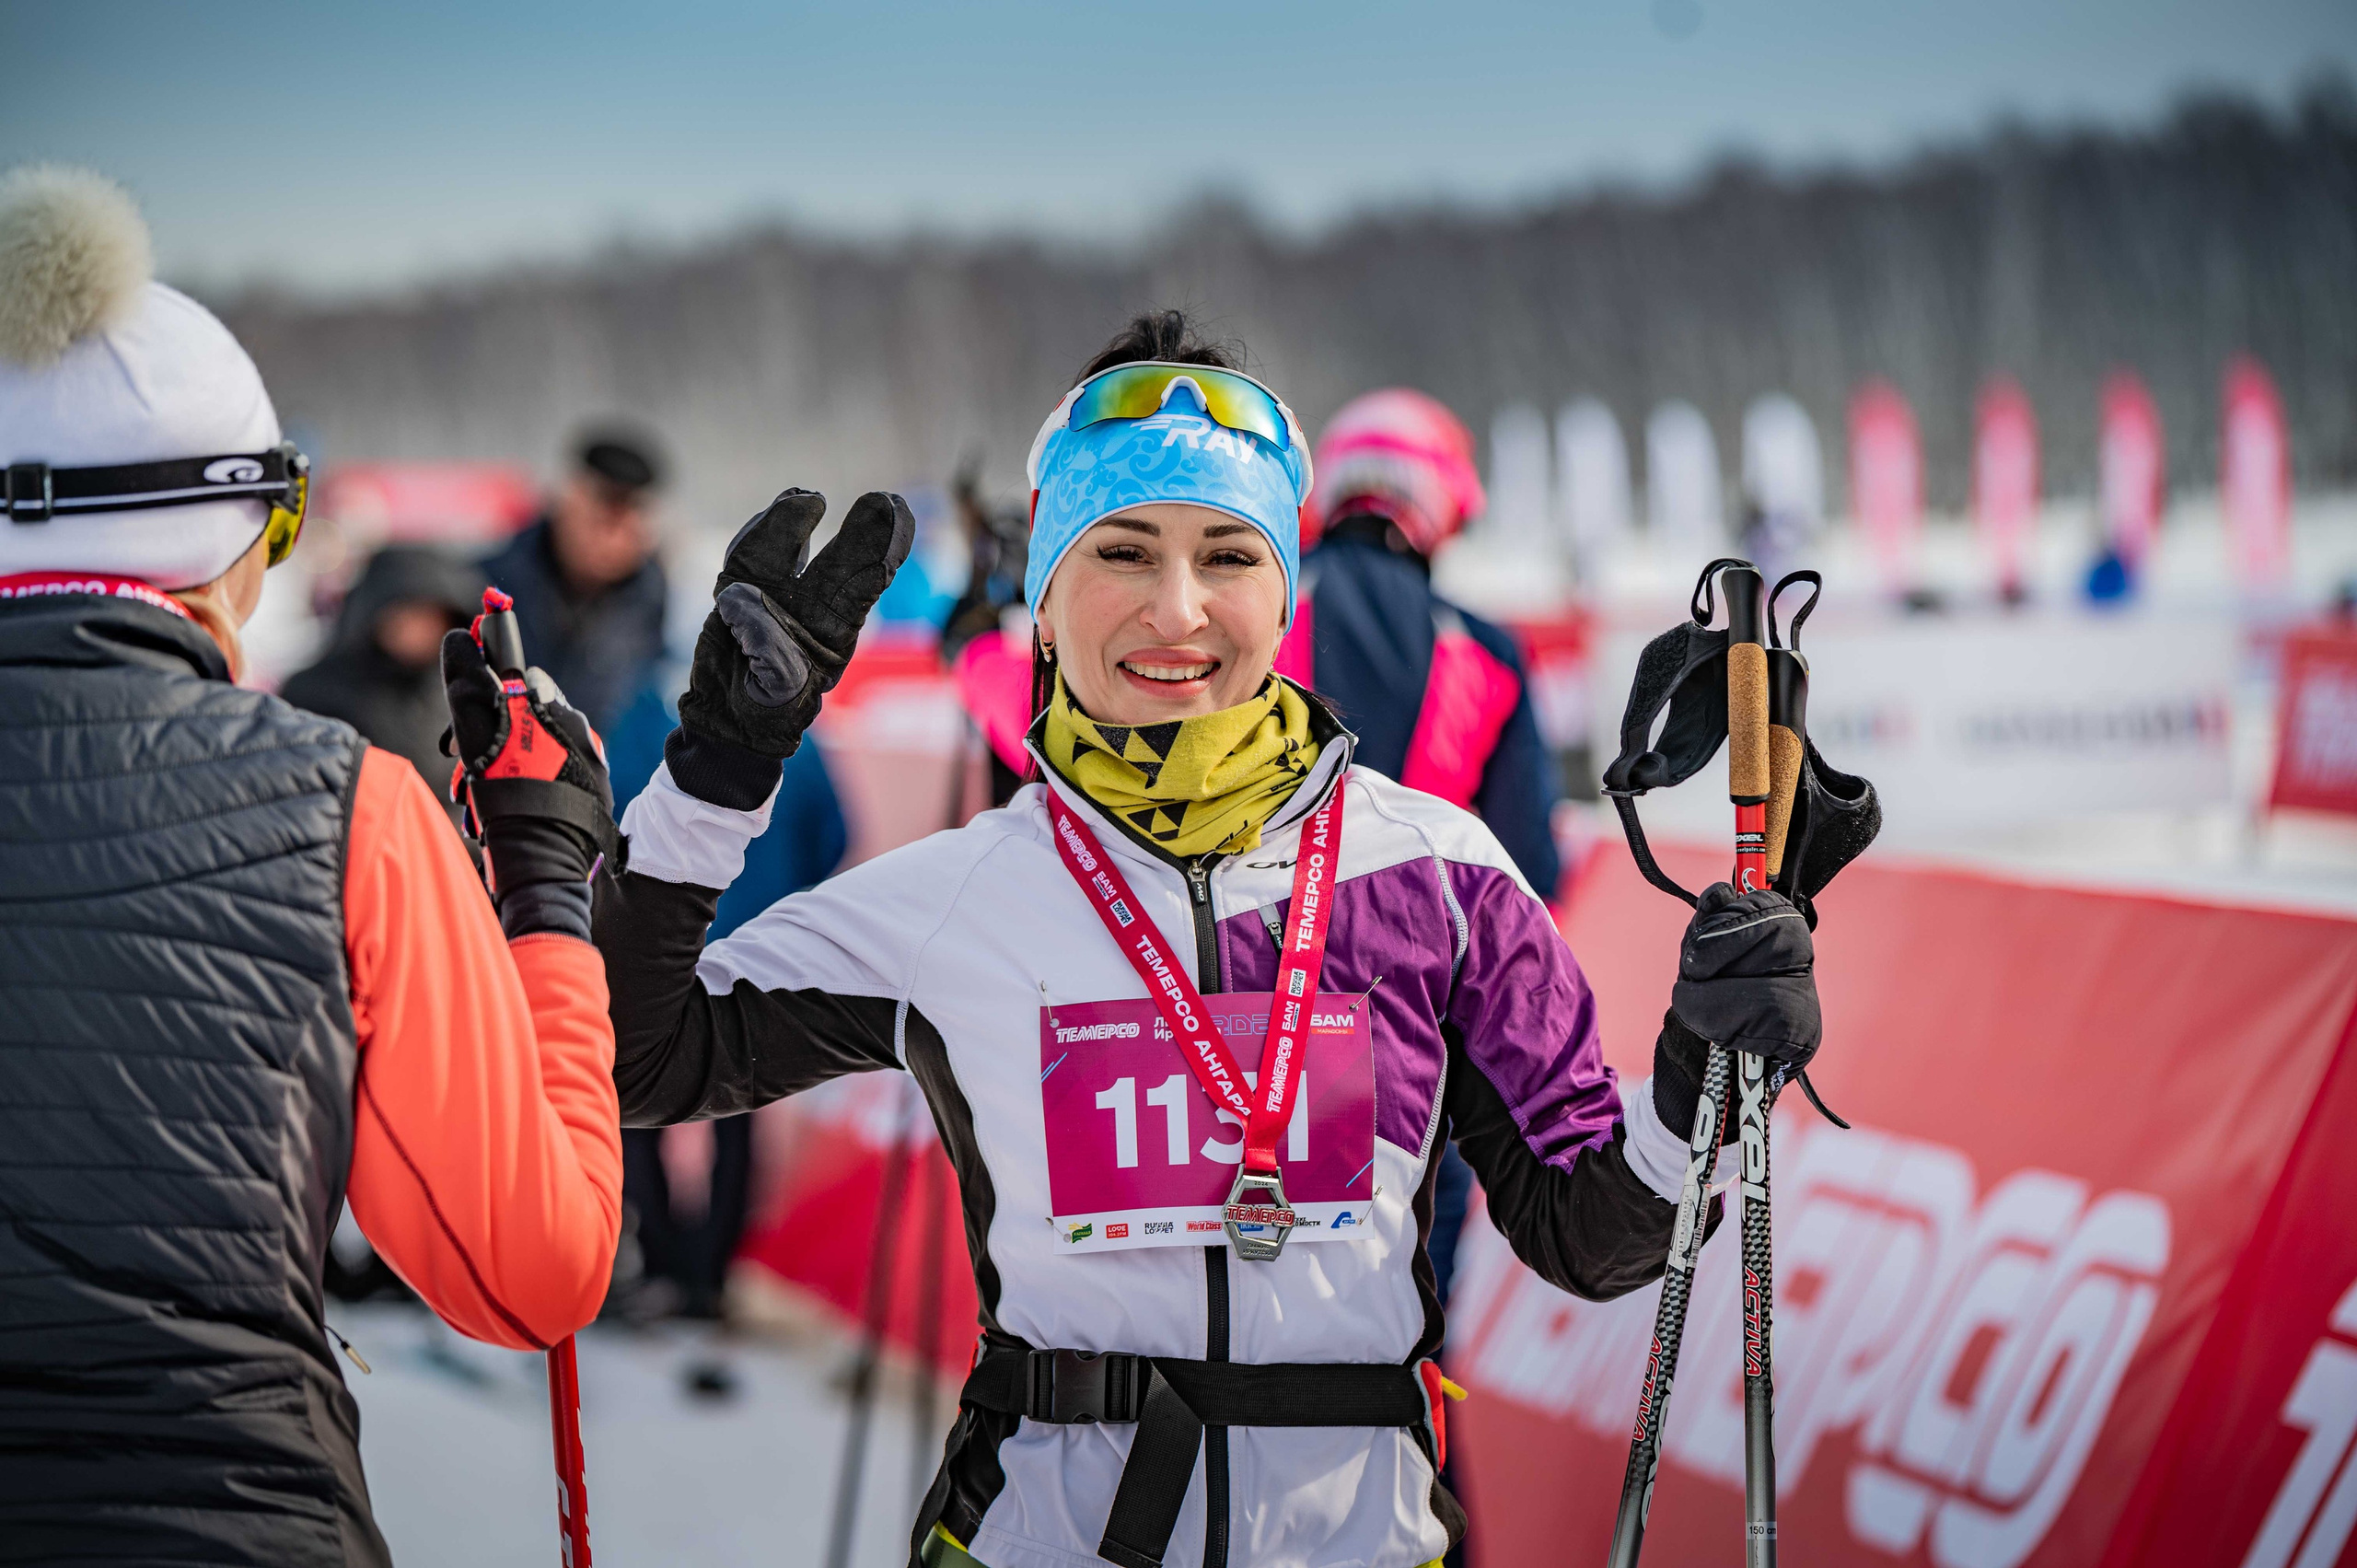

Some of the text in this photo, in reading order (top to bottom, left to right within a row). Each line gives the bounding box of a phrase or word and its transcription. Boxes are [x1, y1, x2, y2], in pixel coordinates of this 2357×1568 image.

[1057, 814, 1118, 897] ТЕМЕРСО БАМ
[1295, 853, 1325, 952] ТЕМЕРСО
[1135, 935, 1199, 1033] ТЕМЕРСО
[1194, 1040, 1251, 1117] АНГАРА
[1310, 1014, 1353, 1027] БАМ
[1056, 1022, 1141, 1043] ТЕМЕРСО
[1266, 1000, 1295, 1113] ТЕМЕРСО БАМ
[1144, 1221, 1174, 1229] RUSSIA
[1225, 1204, 1295, 1225] ТЕМЕРСО
[1108, 1225, 1127, 1233] LOVE
[1188, 1221, 1223, 1232] World Class
[1744, 1265, 1763, 1377] ACTIVA
[1632, 1332, 1663, 1442] ACTIVA
[1748, 1526, 1764, 1535] 150
